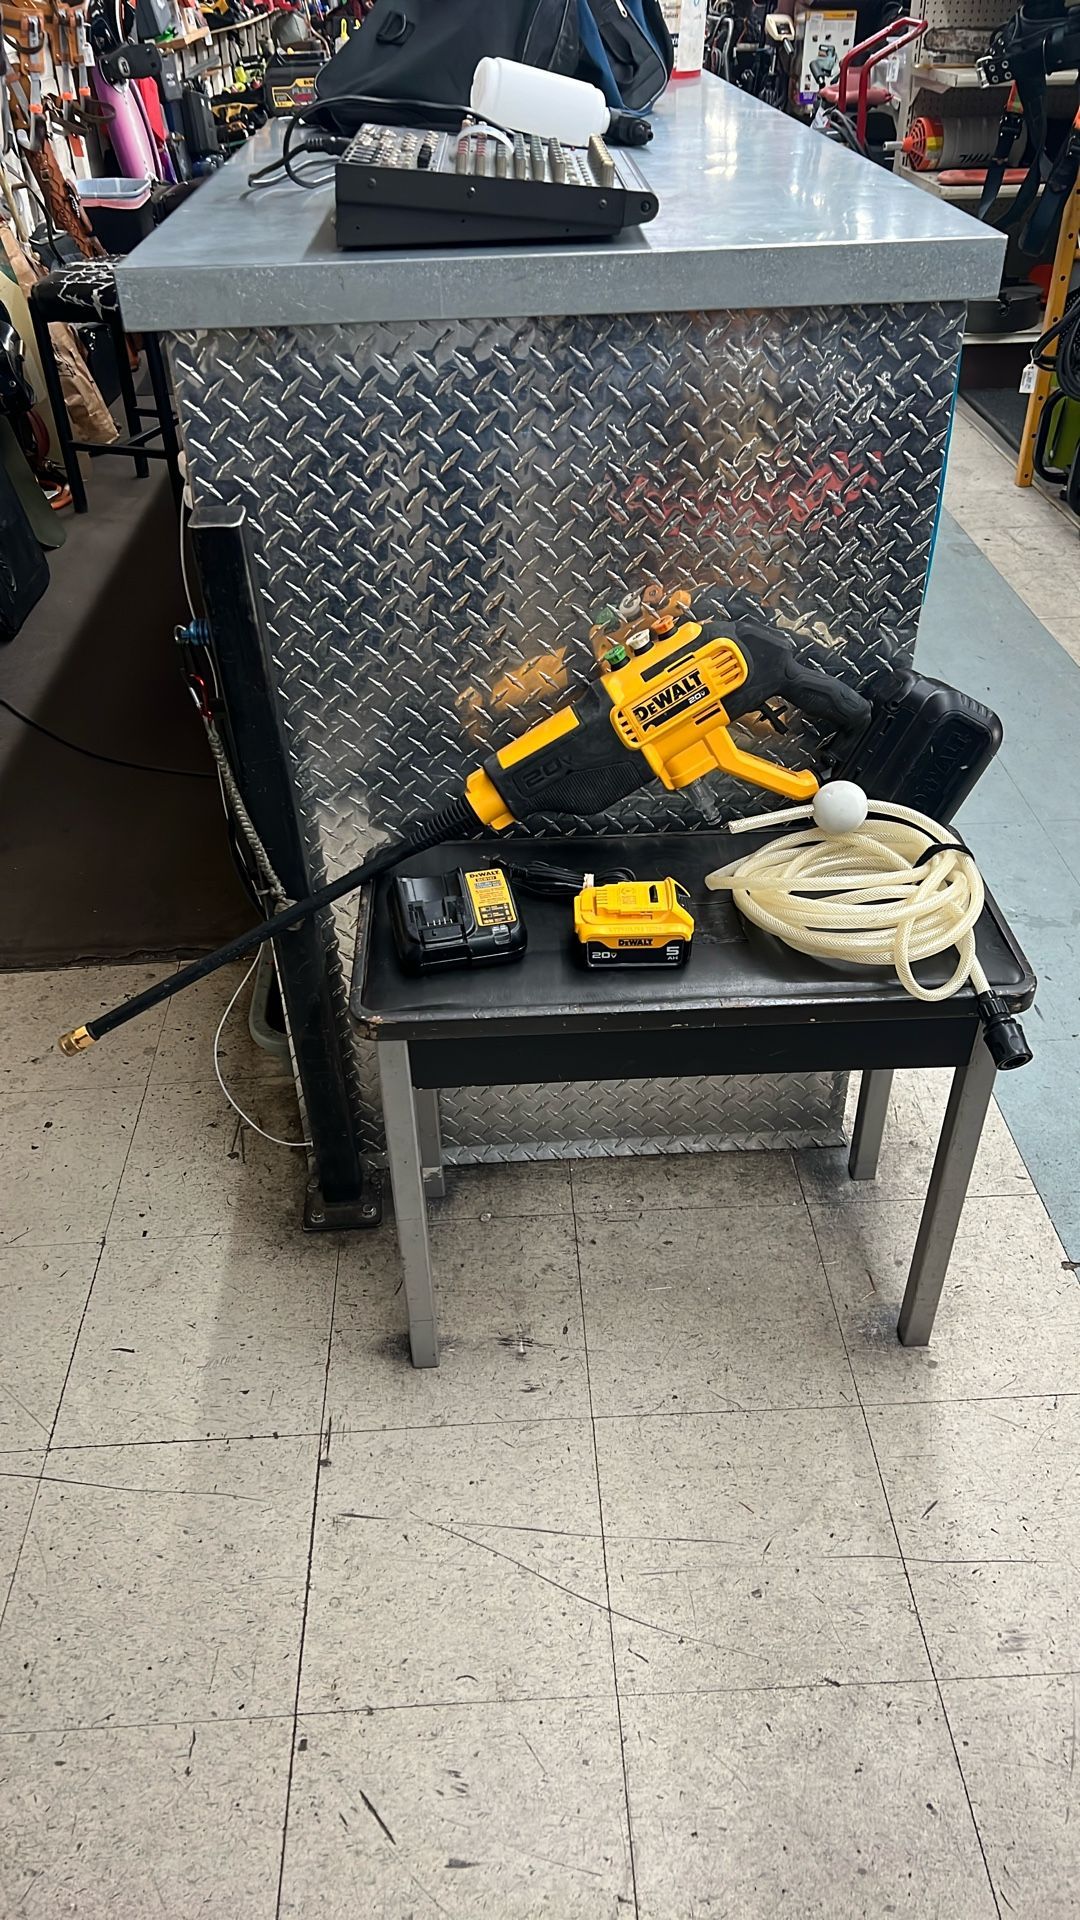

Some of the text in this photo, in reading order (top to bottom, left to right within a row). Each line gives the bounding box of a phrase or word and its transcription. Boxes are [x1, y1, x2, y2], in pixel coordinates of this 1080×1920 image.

[632, 669, 703, 721] DEWALT
[688, 690, 706, 704] 20V
[469, 870, 499, 879] DEWALT
[618, 939, 653, 947] DEWALT
[592, 951, 617, 959] 20V
[666, 946, 680, 956] 5
